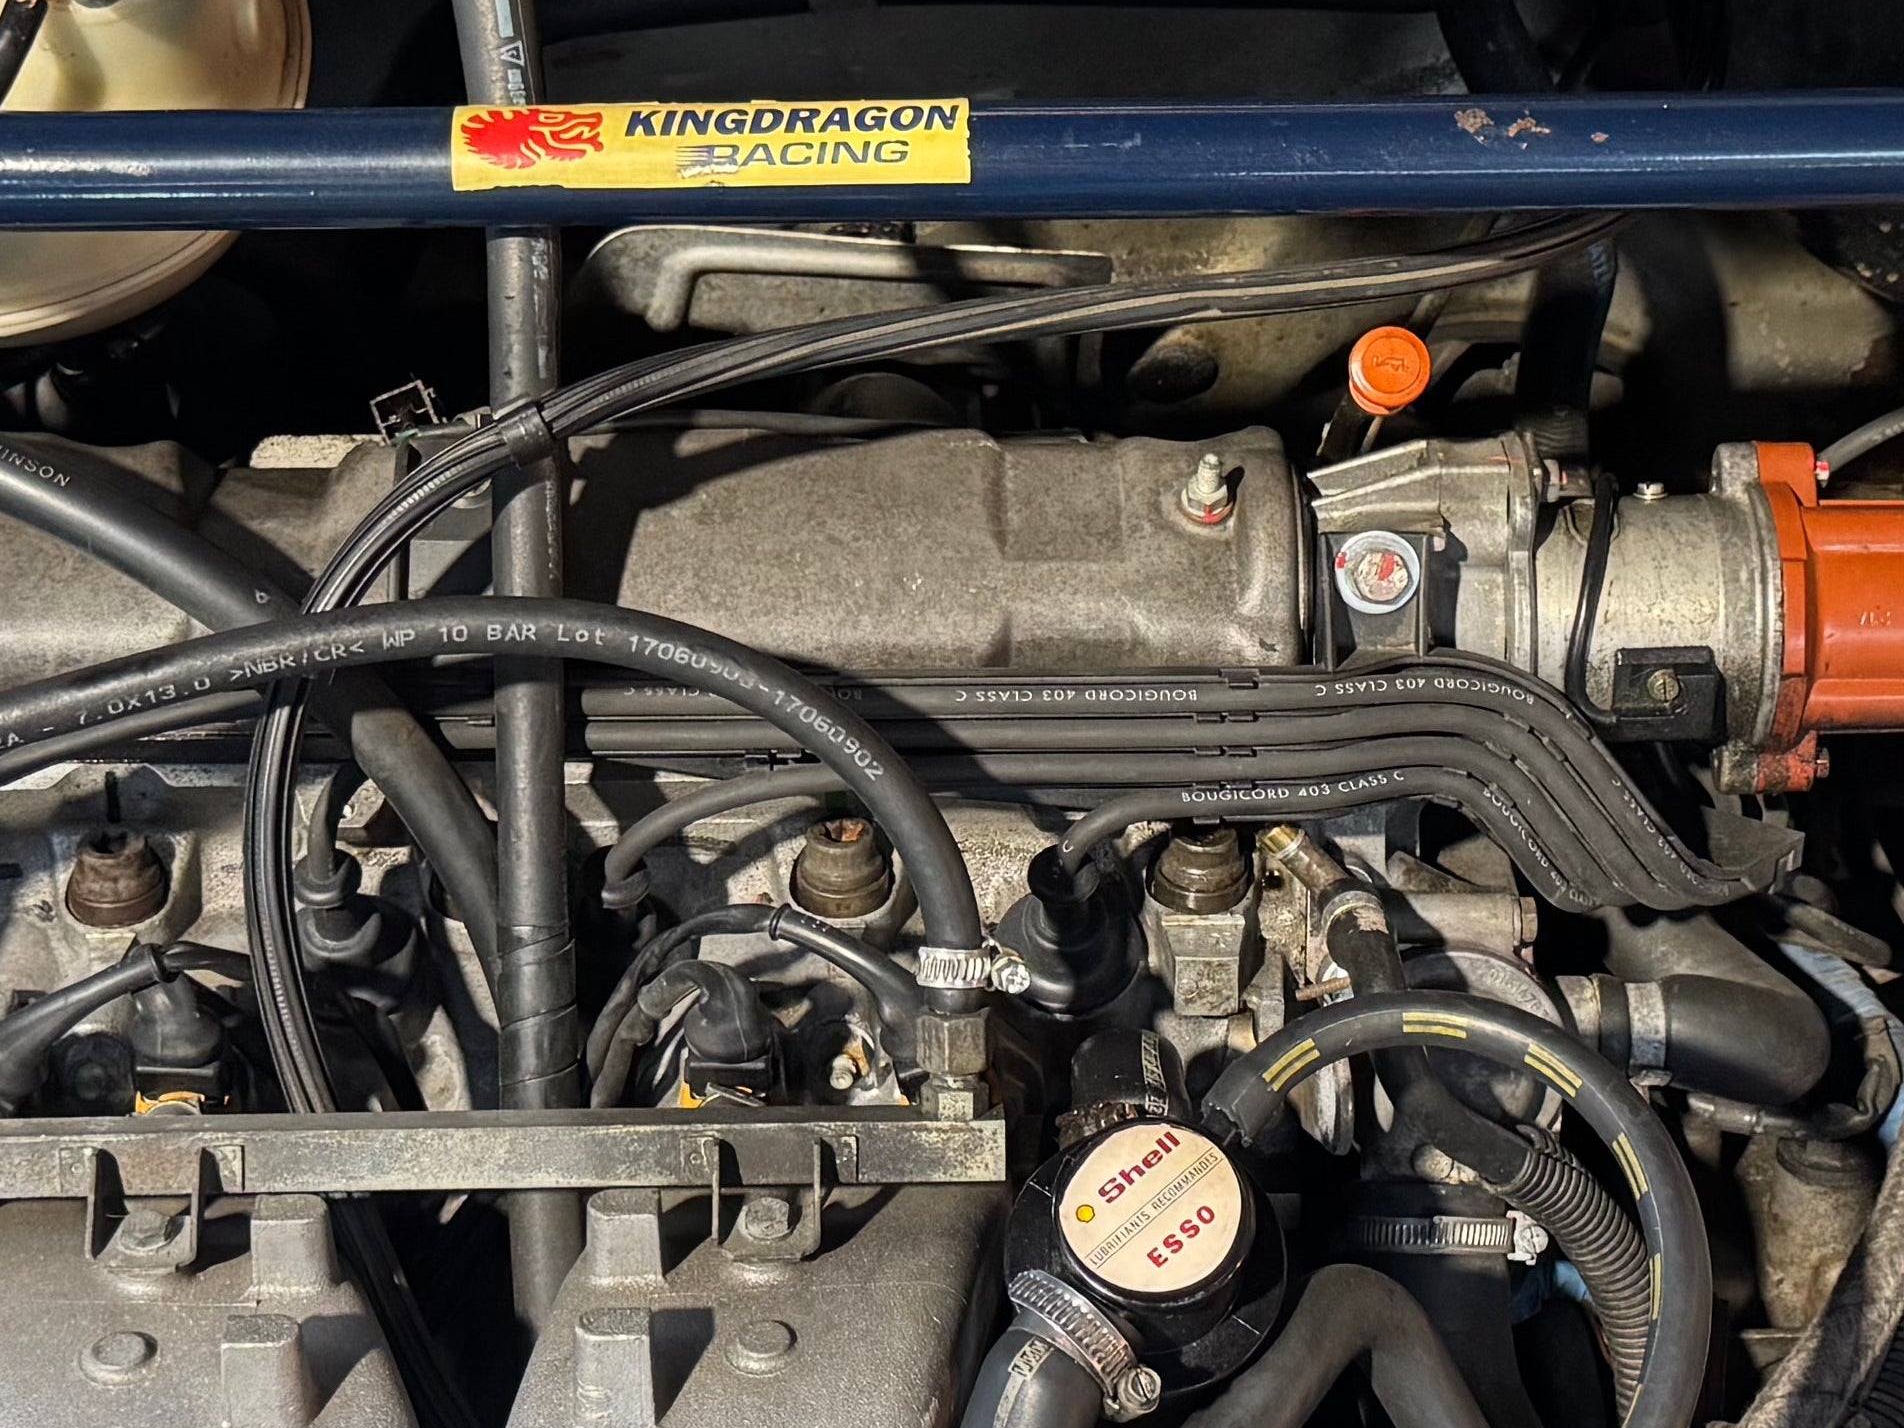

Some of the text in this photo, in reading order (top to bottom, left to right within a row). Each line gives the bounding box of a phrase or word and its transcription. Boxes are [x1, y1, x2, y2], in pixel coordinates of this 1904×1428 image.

[624, 105, 960, 137] KINGDRAGON
[704, 141, 911, 168] RACING
[382, 628, 416, 651] WP
[437, 624, 469, 644] 10
[485, 623, 538, 643] BAR
[556, 623, 607, 647] Lot
[954, 689, 1197, 702] BOUGICORD 403 CLASS C
[1314, 677, 1536, 706] BOUGICORD 403 CLASS C
[1182, 770, 1406, 803] BOUGICORD 403 CLASS C
[1098, 1131, 1181, 1203] Shell
[1089, 1152, 1218, 1266] LUBRIFIANTS RECOMMANDES
[1147, 1205, 1215, 1268] ESSO
